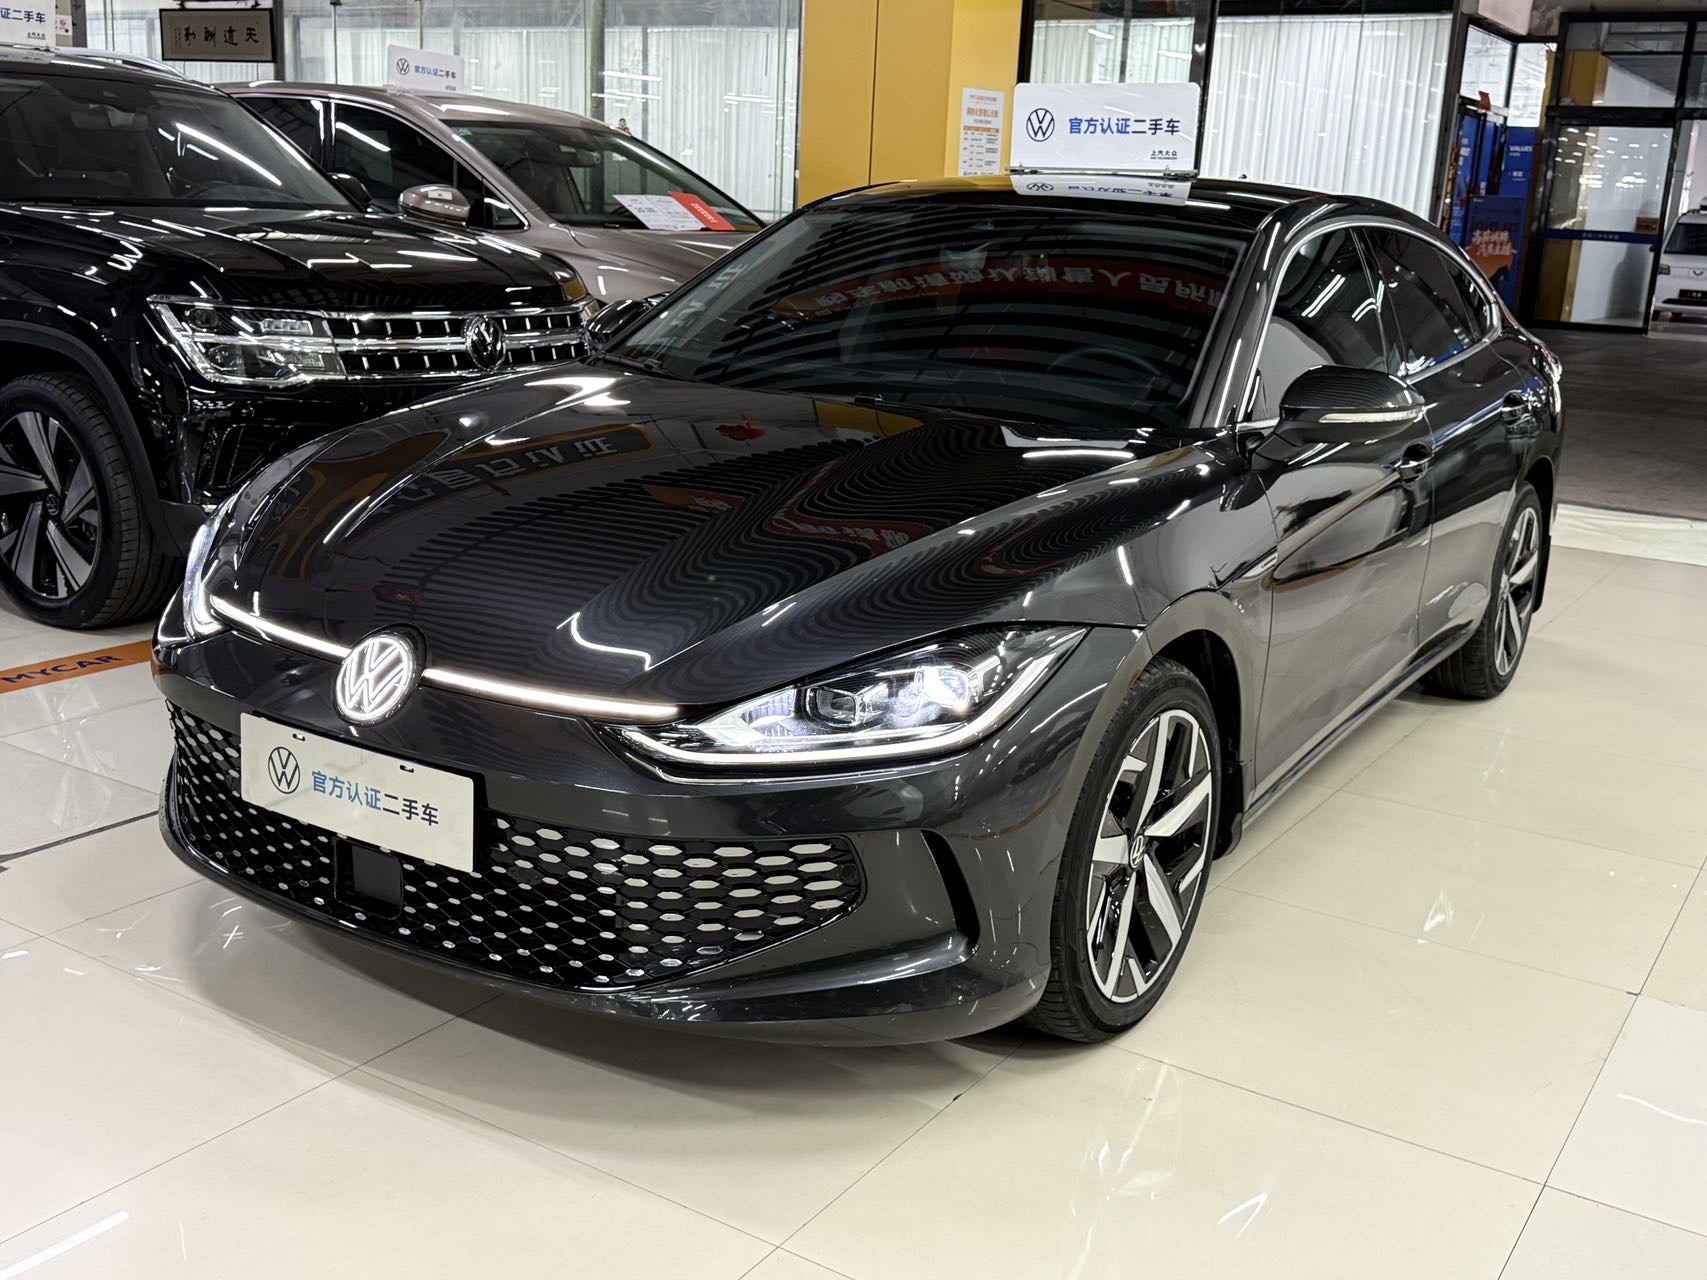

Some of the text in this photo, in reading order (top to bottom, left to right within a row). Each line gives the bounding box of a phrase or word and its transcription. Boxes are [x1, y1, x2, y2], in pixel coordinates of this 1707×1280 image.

[1068, 117, 1180, 136] 官方认证二手车
[1, 655, 122, 683] MYCAR
[311, 770, 439, 827] 官方认证二手车
